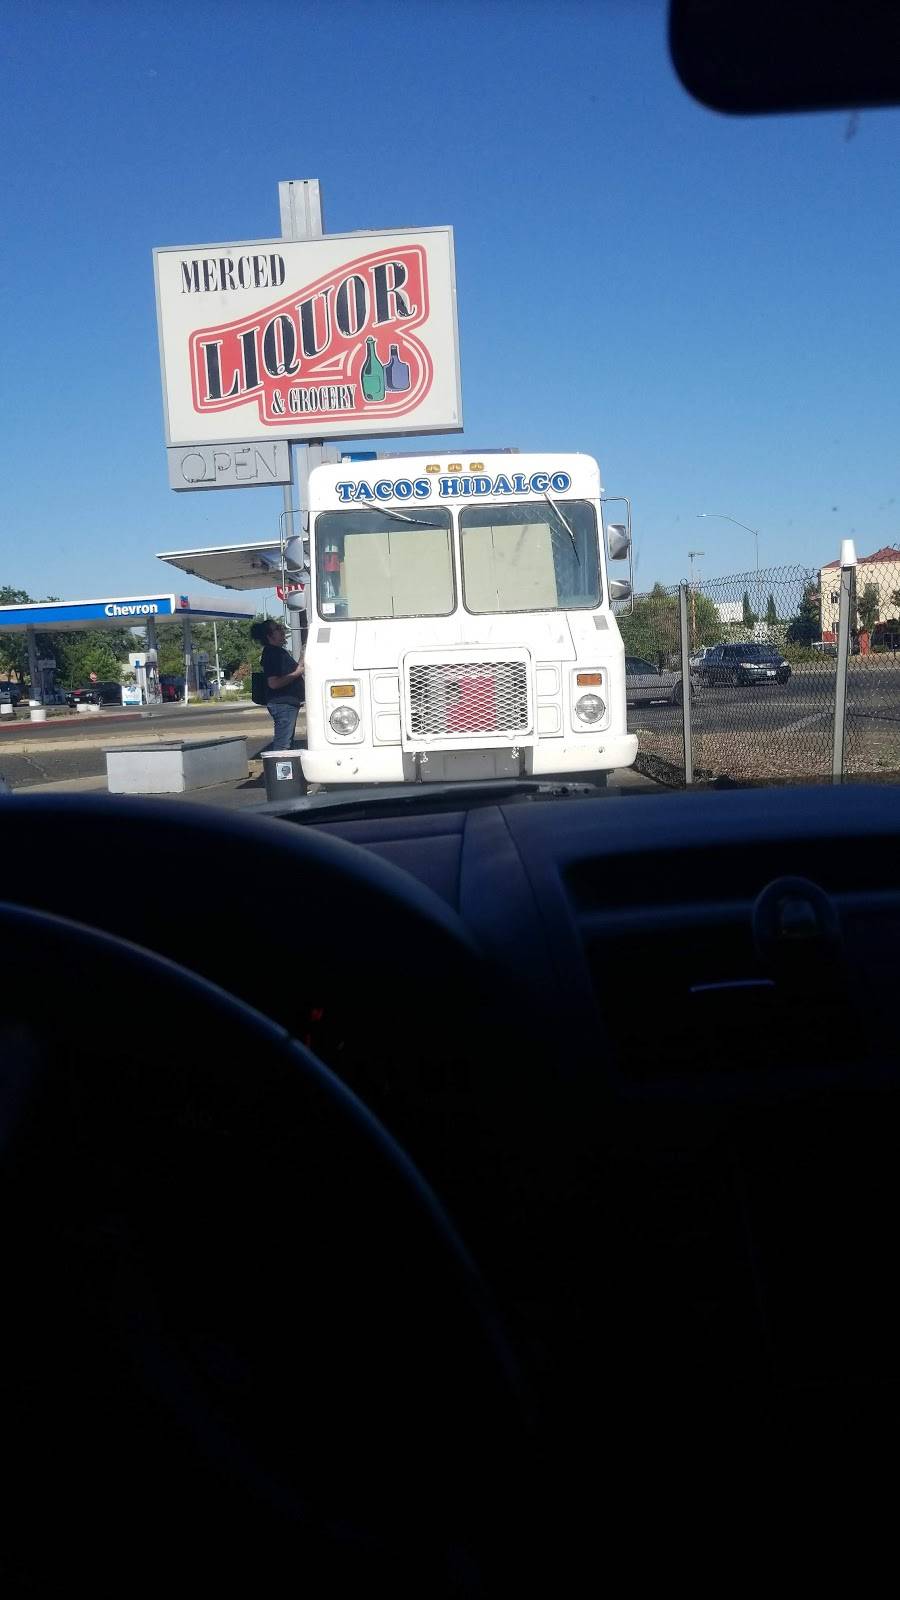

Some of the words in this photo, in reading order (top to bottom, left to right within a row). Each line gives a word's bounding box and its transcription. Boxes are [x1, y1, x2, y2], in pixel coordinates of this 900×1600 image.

[180, 253, 286, 294] MERCED
[201, 261, 416, 401] LIQUOR
[271, 390, 285, 413] &
[289, 384, 356, 412] GROCERY
[180, 446, 278, 483] OPEN
[335, 478, 432, 503] TACOS
[438, 471, 572, 497] HIDALGO
[104, 603, 158, 617] Chevron
